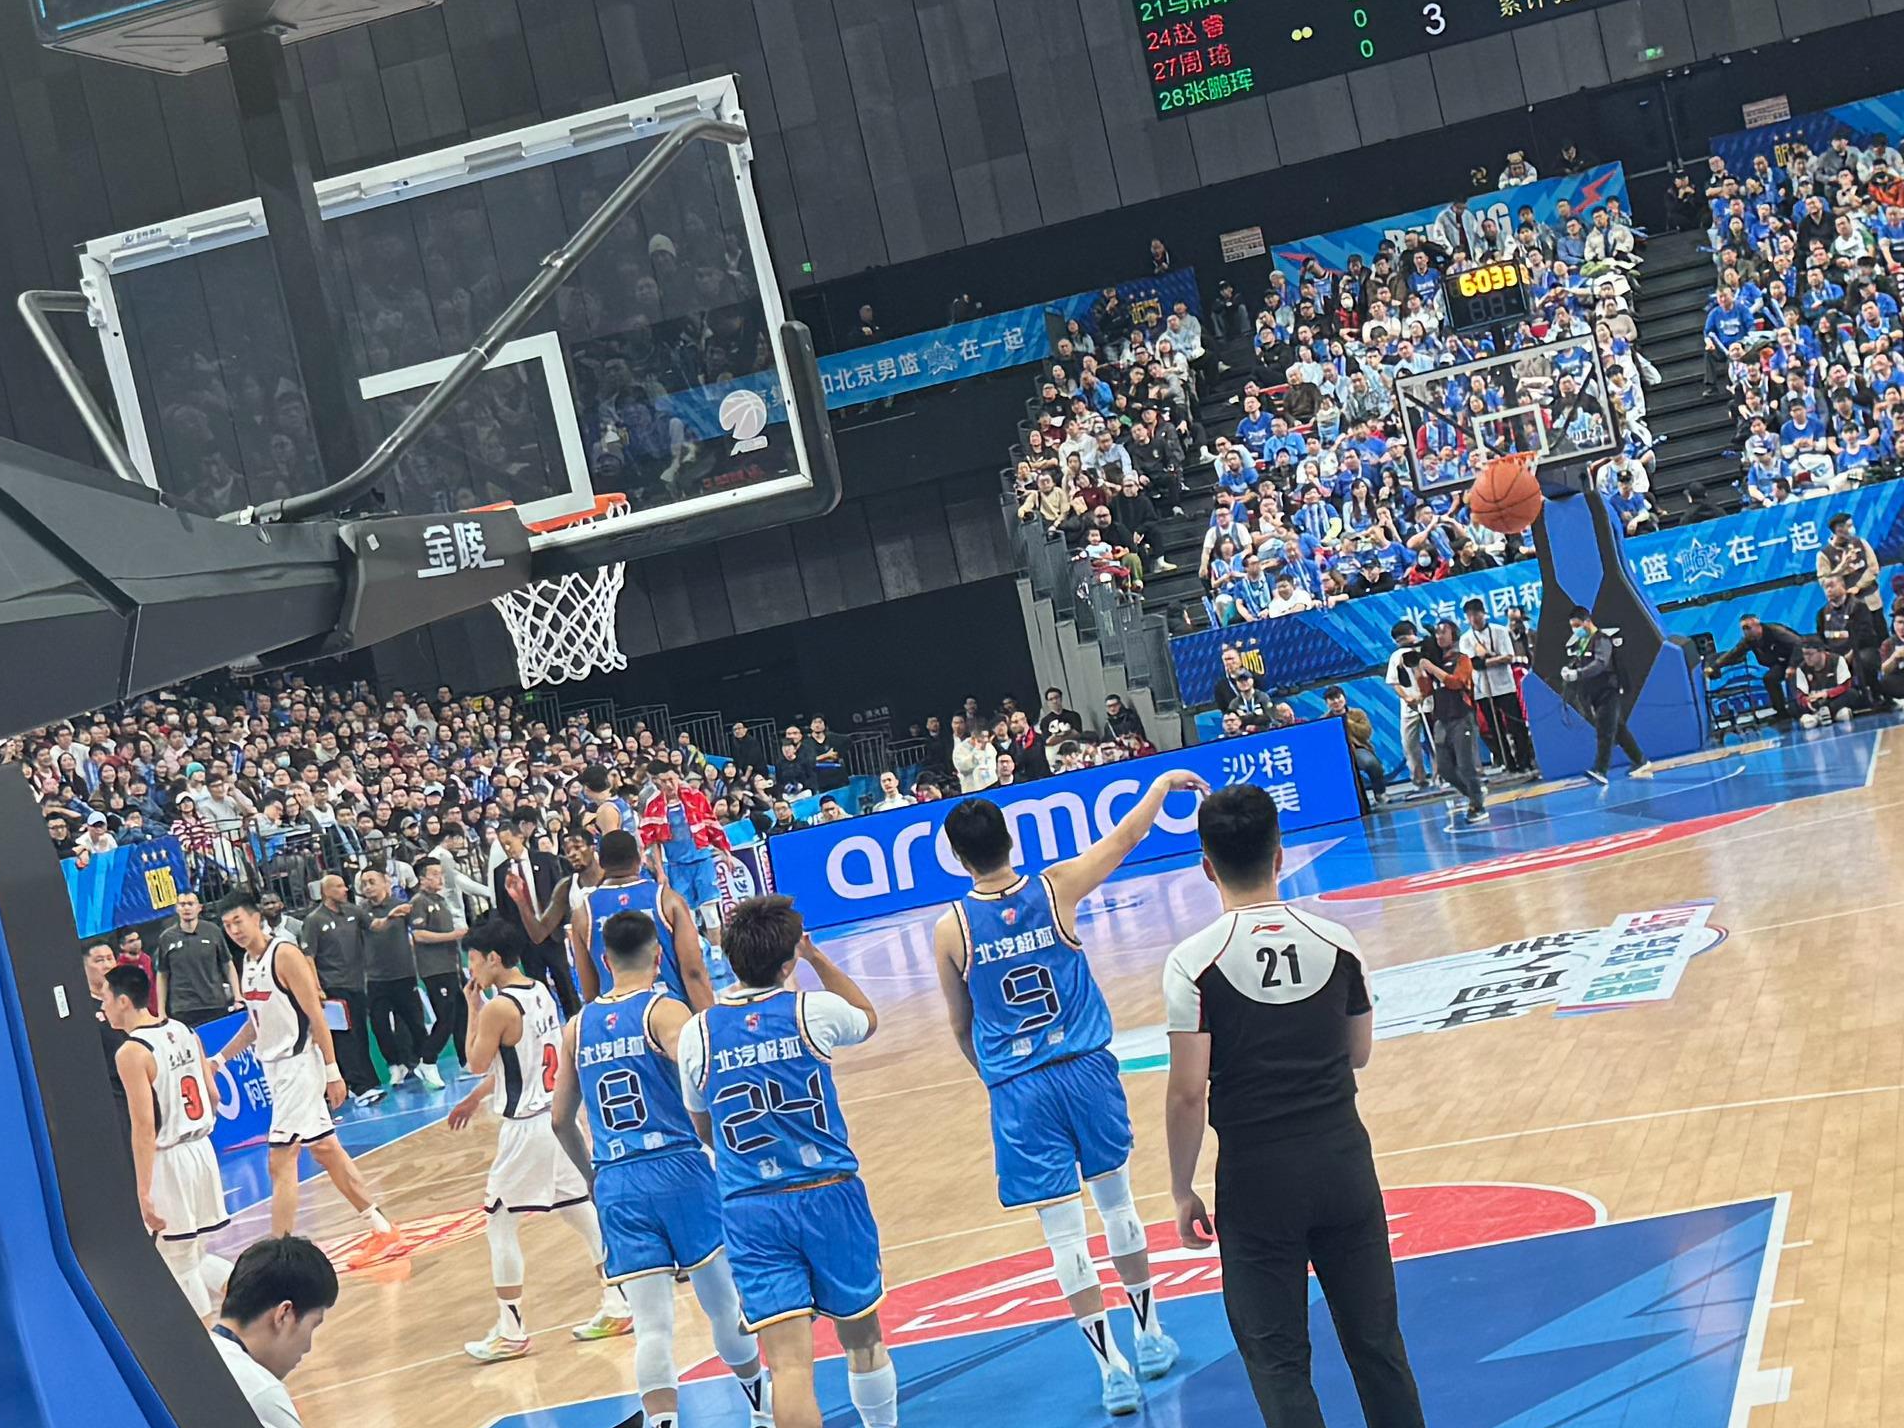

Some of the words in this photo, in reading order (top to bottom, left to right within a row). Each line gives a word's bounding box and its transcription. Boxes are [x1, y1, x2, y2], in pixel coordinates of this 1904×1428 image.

[1353, 8, 1368, 28] 0
[1423, 3, 1446, 36] 3
[1360, 39, 1374, 58] 0
[959, 326, 1025, 361] 在一起
[417, 520, 505, 579] 金陵
[1726, 522, 1822, 567] 在一起
[1222, 745, 1294, 787] 沙特
[1255, 944, 1302, 990] 21
[999, 963, 1062, 1034] 9
[179, 1075, 204, 1121] 3
[597, 1068, 649, 1132] 8
[711, 1067, 831, 1155] 24
